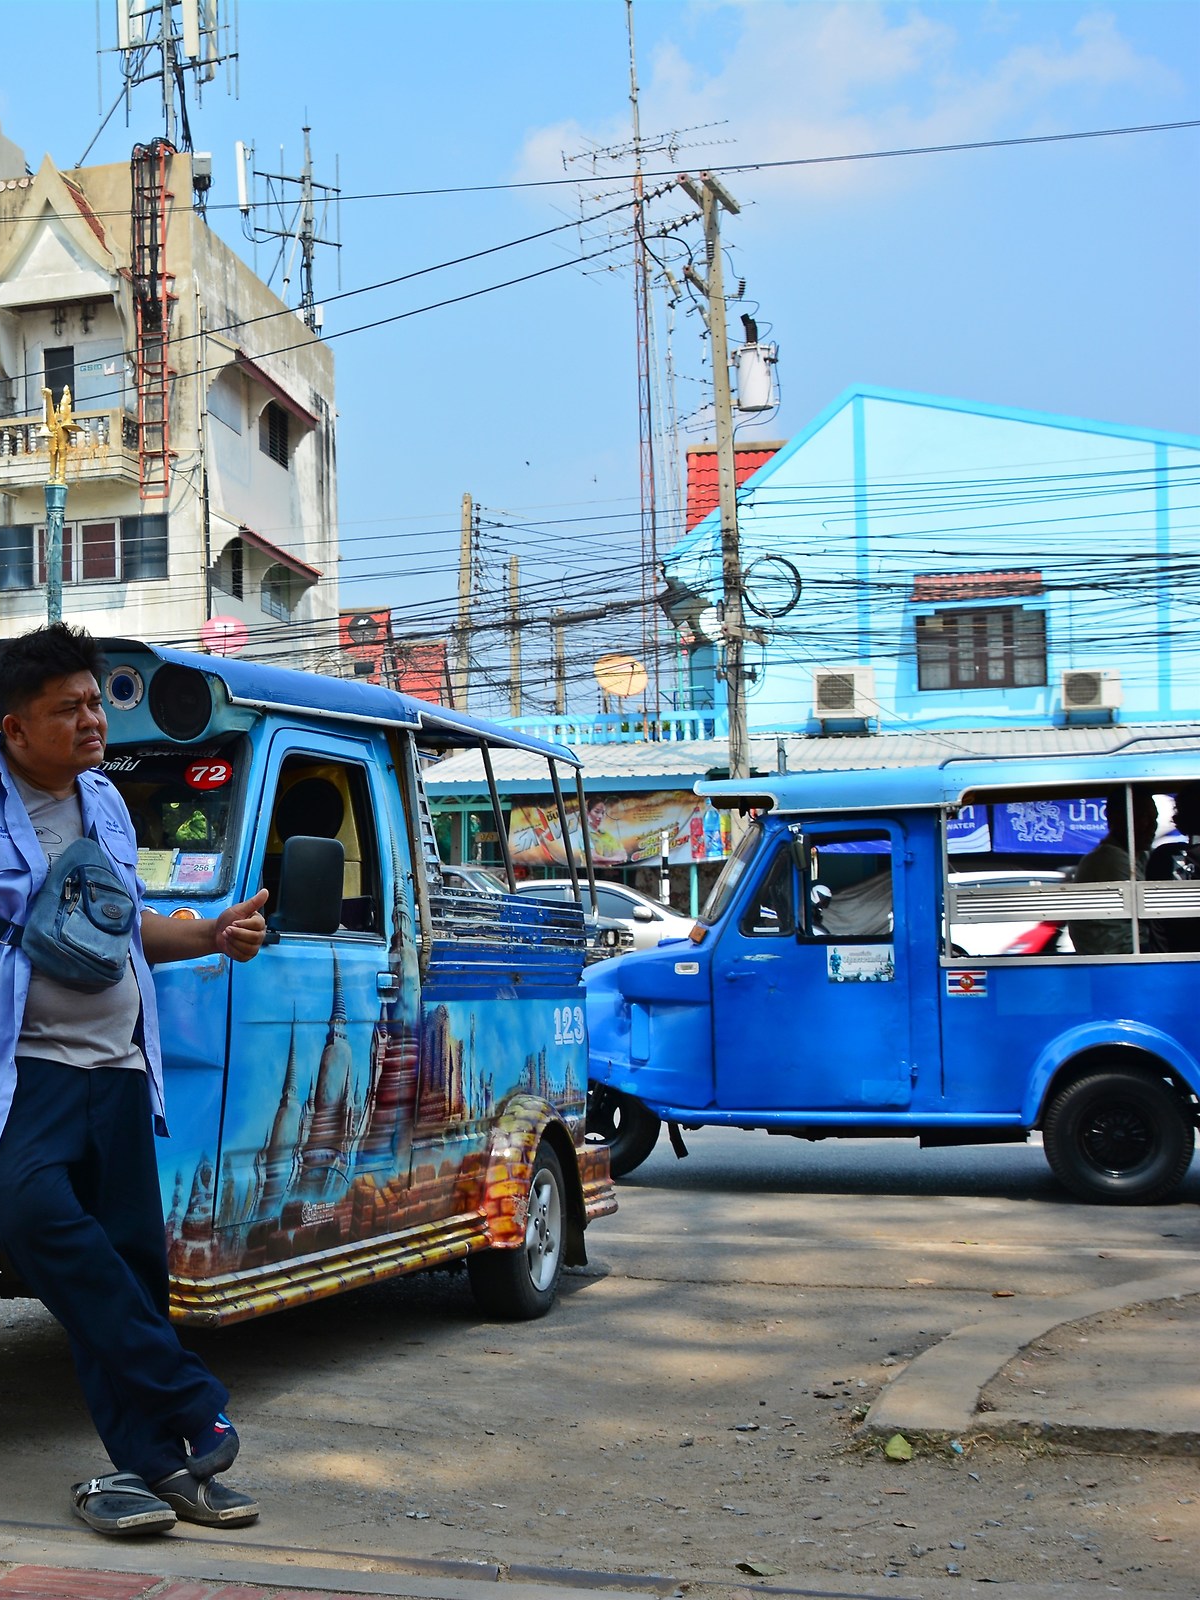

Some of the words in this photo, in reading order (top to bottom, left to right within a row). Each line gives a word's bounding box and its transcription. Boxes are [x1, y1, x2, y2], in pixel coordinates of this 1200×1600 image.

[191, 765, 227, 782] 72
[1069, 823, 1106, 831] SINGHA
[553, 1006, 585, 1046] 123
